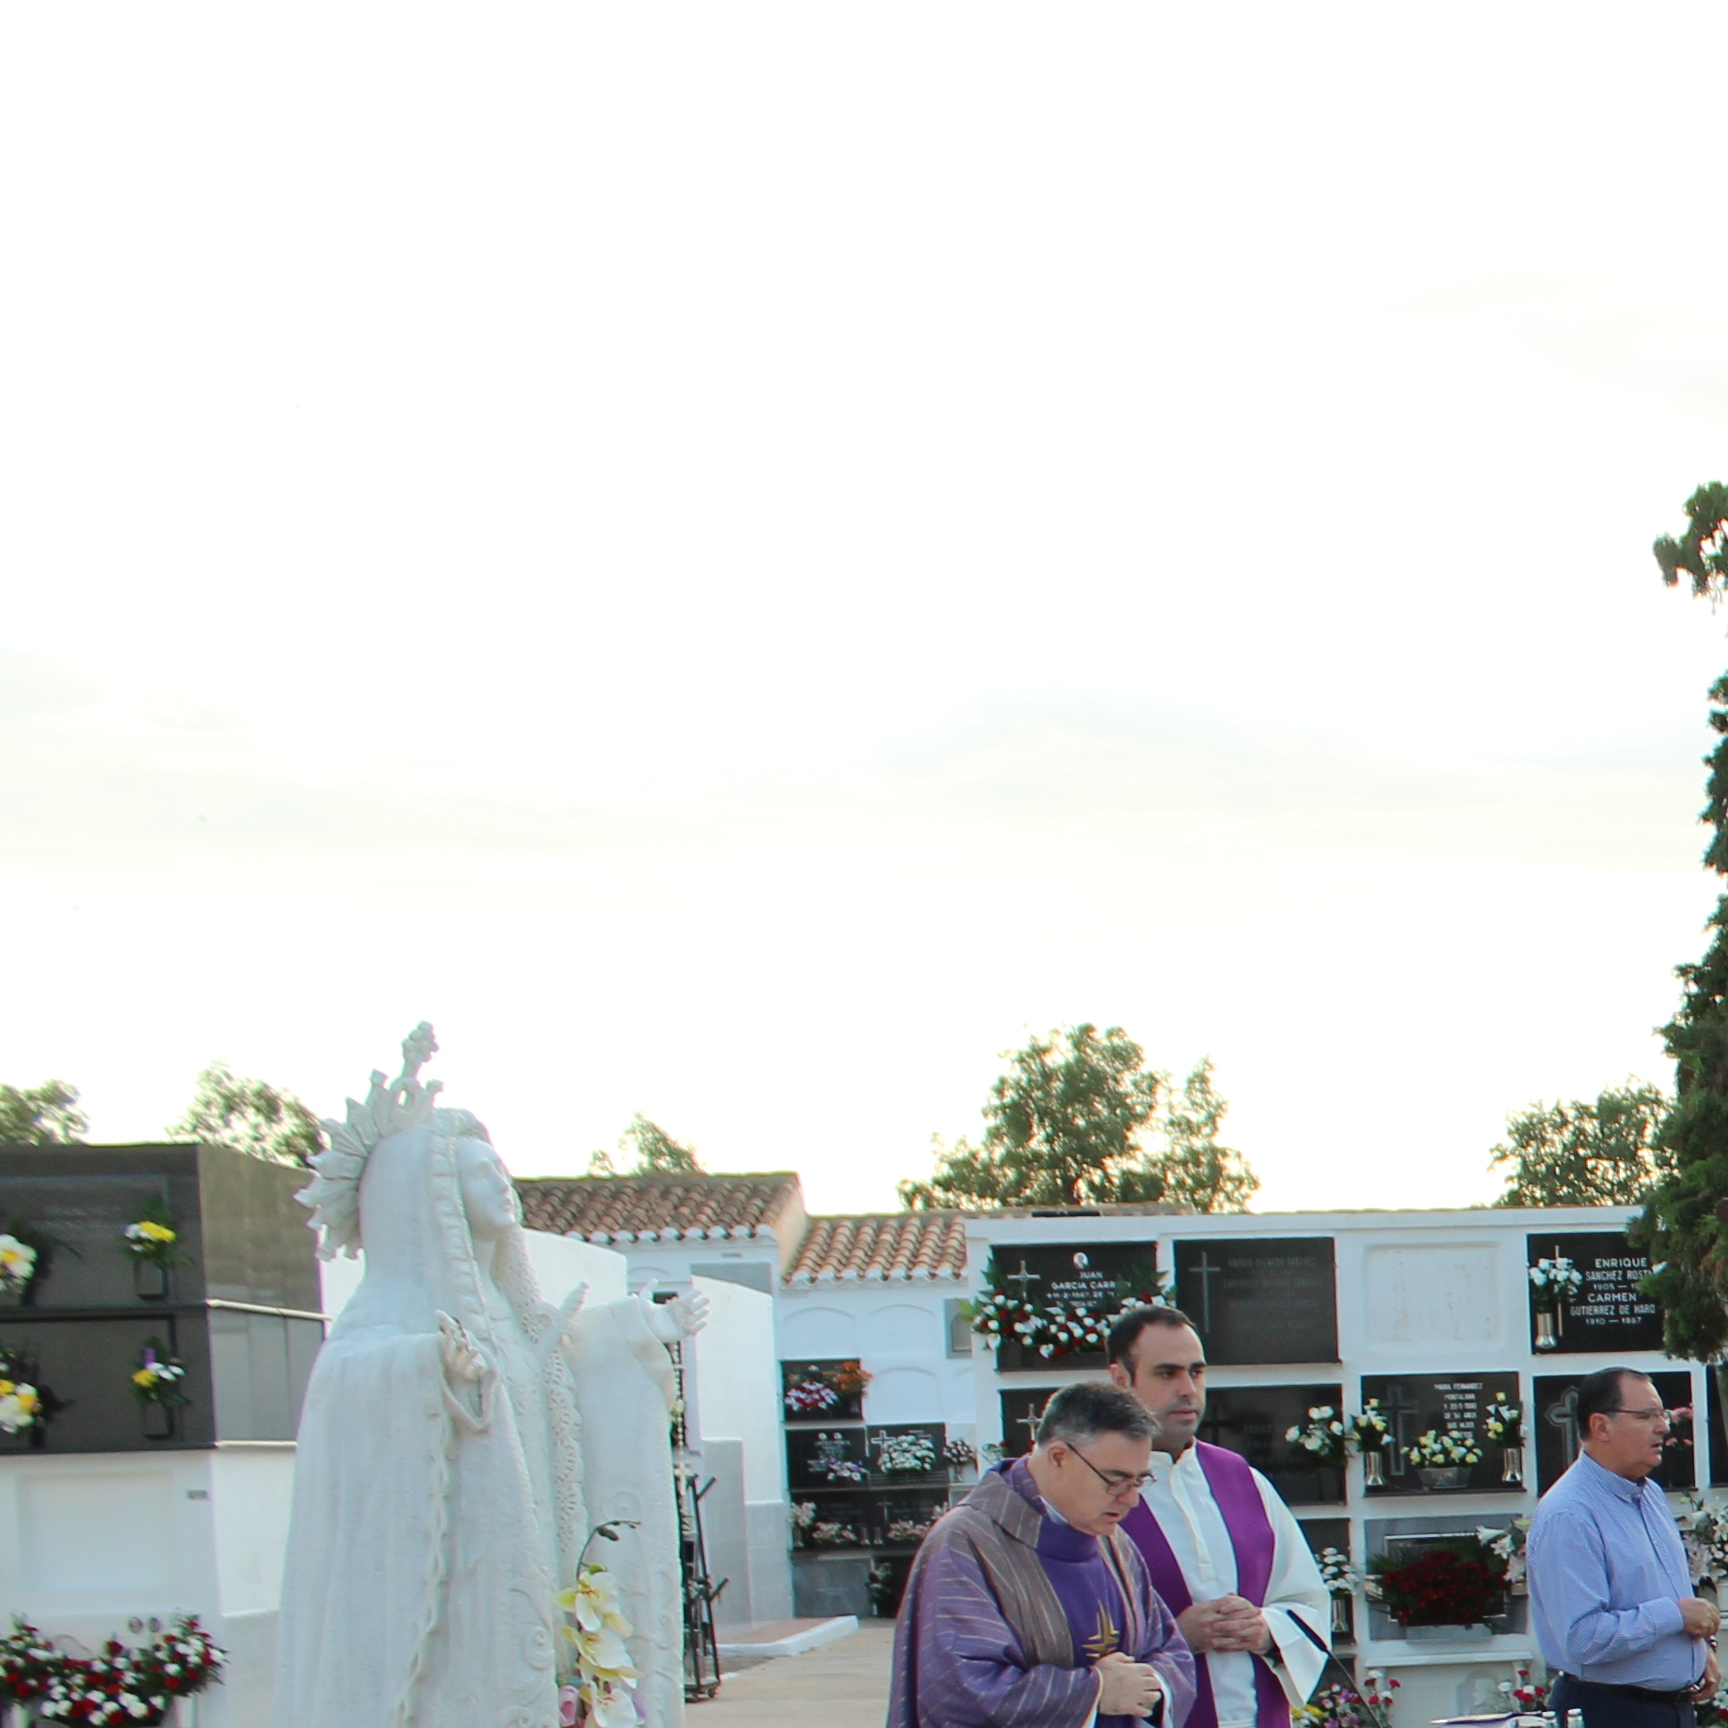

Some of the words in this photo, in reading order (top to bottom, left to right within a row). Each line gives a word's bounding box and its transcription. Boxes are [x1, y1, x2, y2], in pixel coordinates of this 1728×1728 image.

[1595, 1257, 1648, 1269] ENRIQUE
[1079, 1271, 1104, 1280] JUAN
[1051, 1281, 1087, 1291] GARCIA
[1587, 1292, 1637, 1303] CARMEN
[1570, 1305, 1615, 1316] GUTIERREZ
[1619, 1304, 1631, 1315] DE
